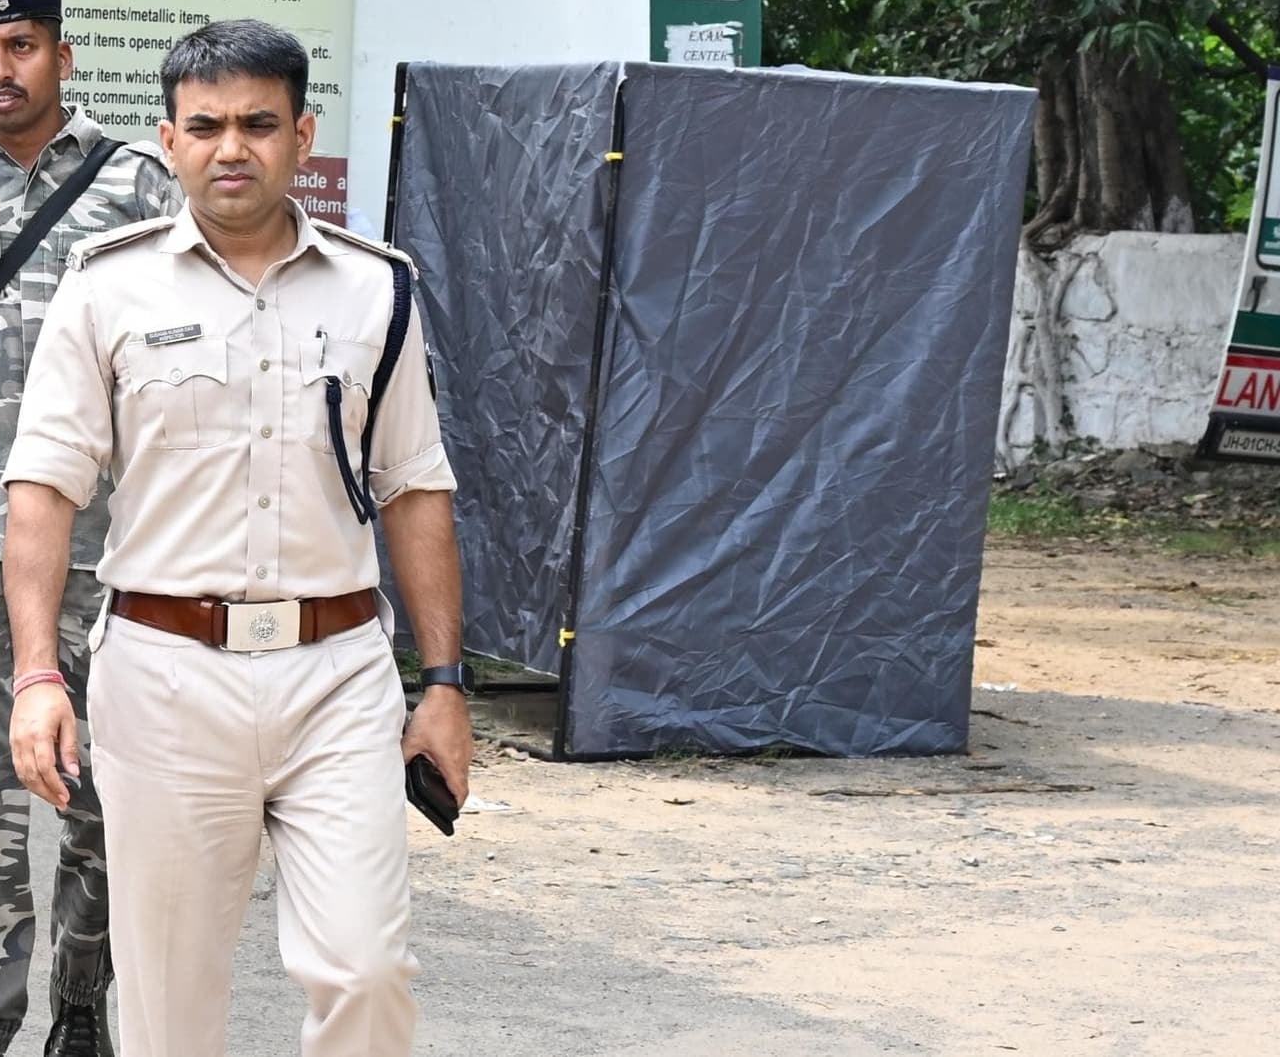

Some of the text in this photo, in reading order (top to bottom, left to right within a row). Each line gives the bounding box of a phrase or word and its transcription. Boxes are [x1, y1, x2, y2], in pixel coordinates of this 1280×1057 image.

[64, 6, 176, 24] ornaments/metallic
[64, 31, 172, 52] food items opened
[311, 46, 332, 60] etc.
[71, 66, 160, 84] ther item which
[93, 90, 165, 105] communicat
